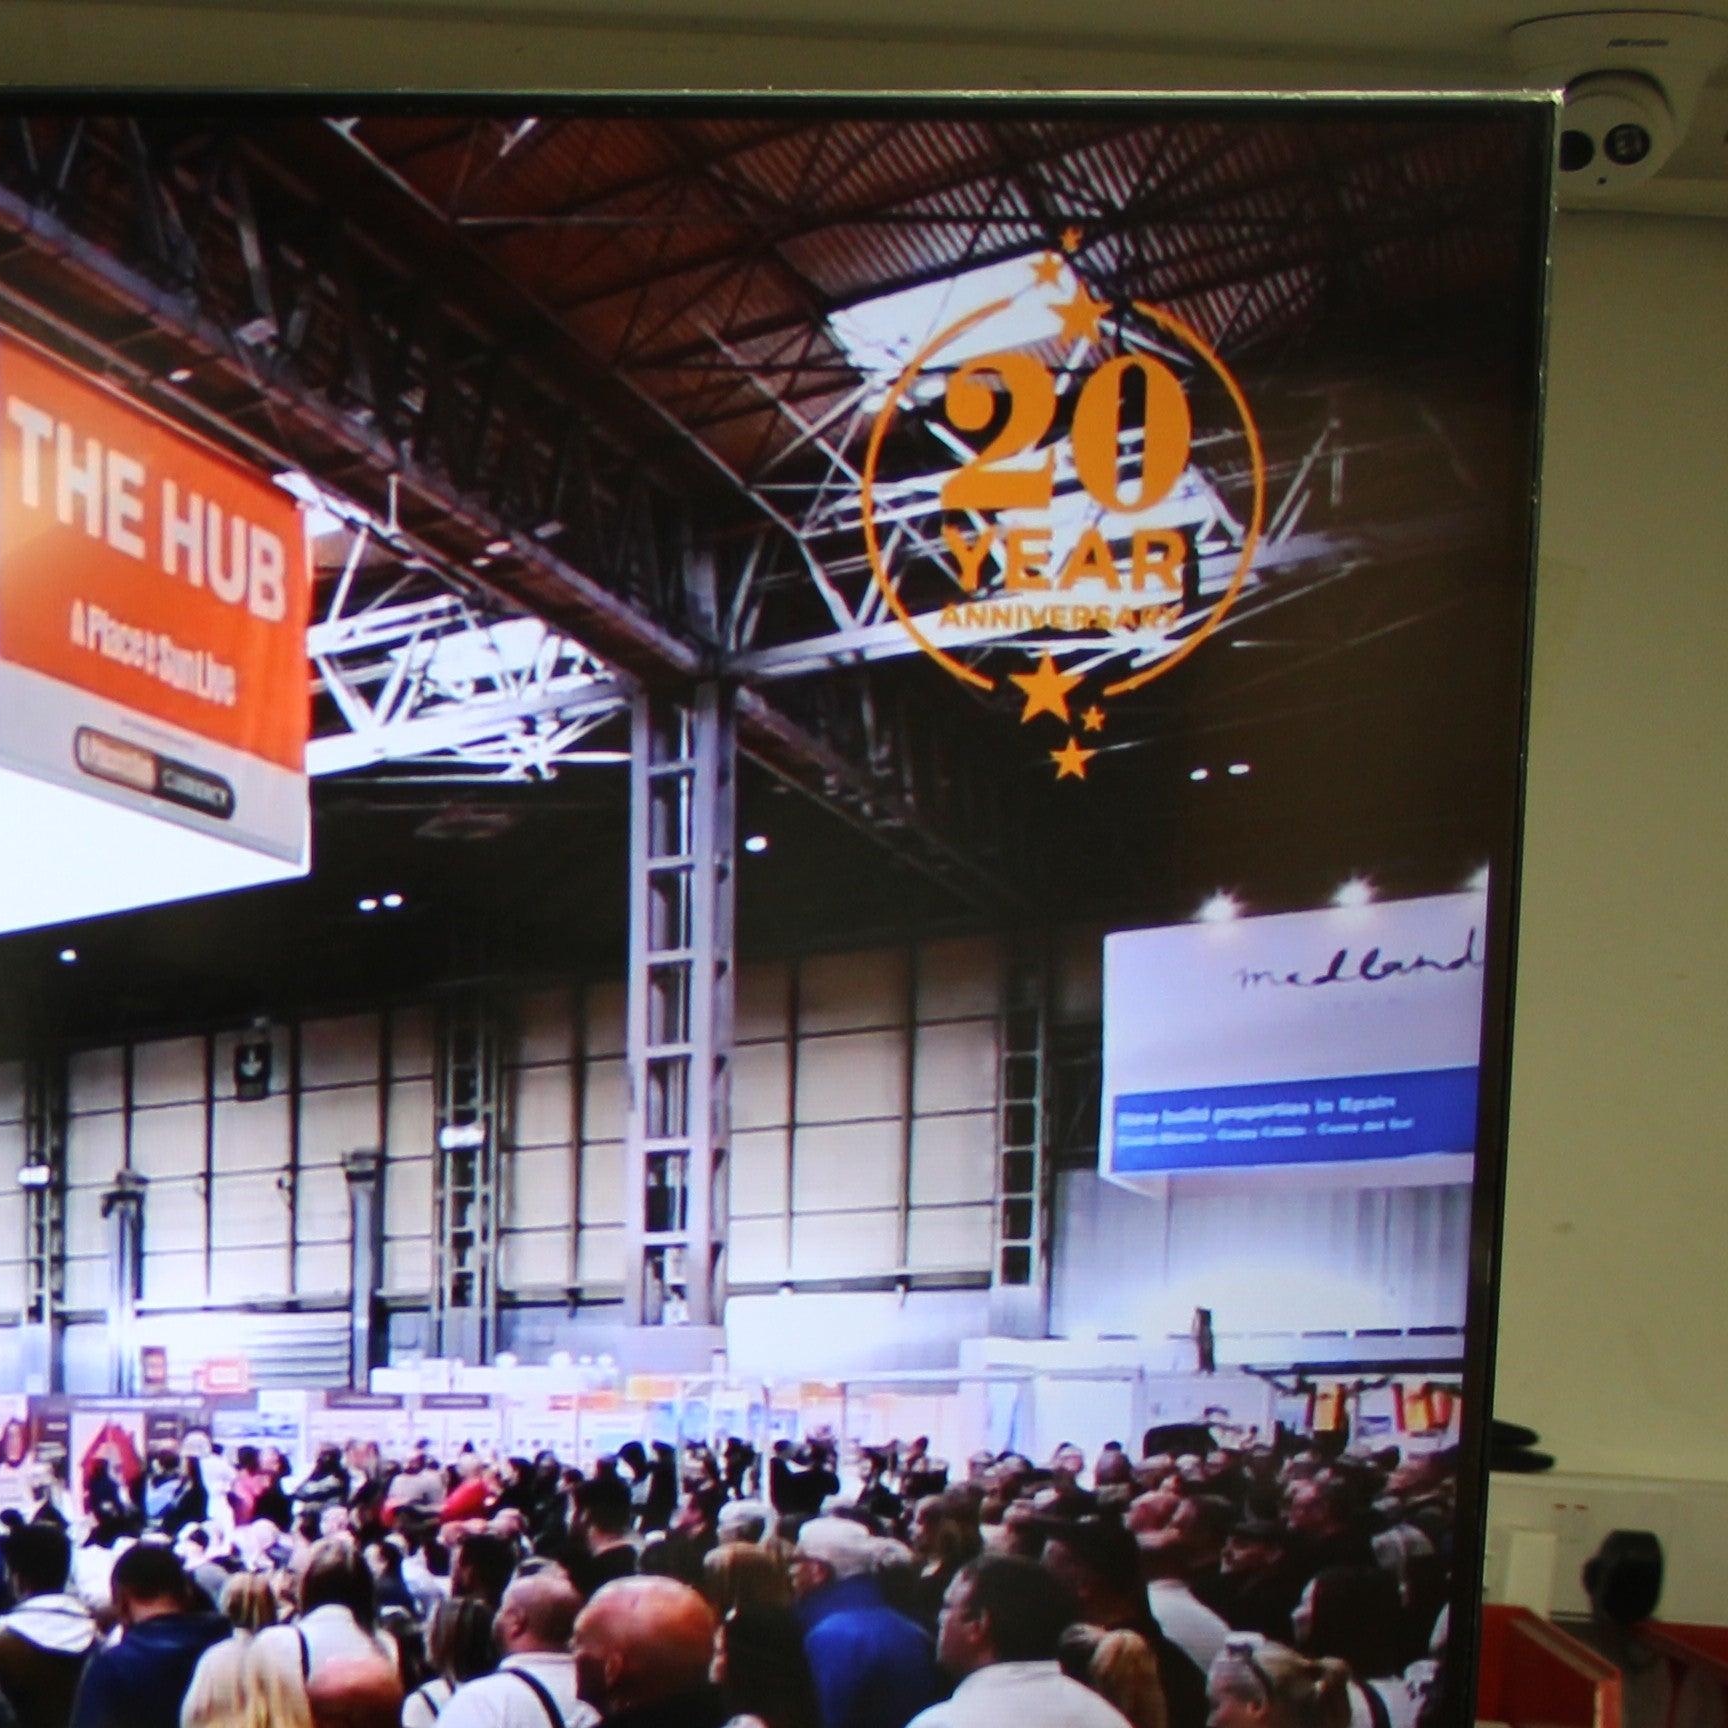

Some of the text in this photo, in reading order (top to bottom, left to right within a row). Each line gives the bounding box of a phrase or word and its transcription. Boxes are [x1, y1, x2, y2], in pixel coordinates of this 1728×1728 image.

[940, 354, 1192, 514] 20
[7, 395, 286, 623] THE HUB
[946, 528, 1188, 592] YEAR
[937, 602, 1184, 630] ANNIVERSARY
